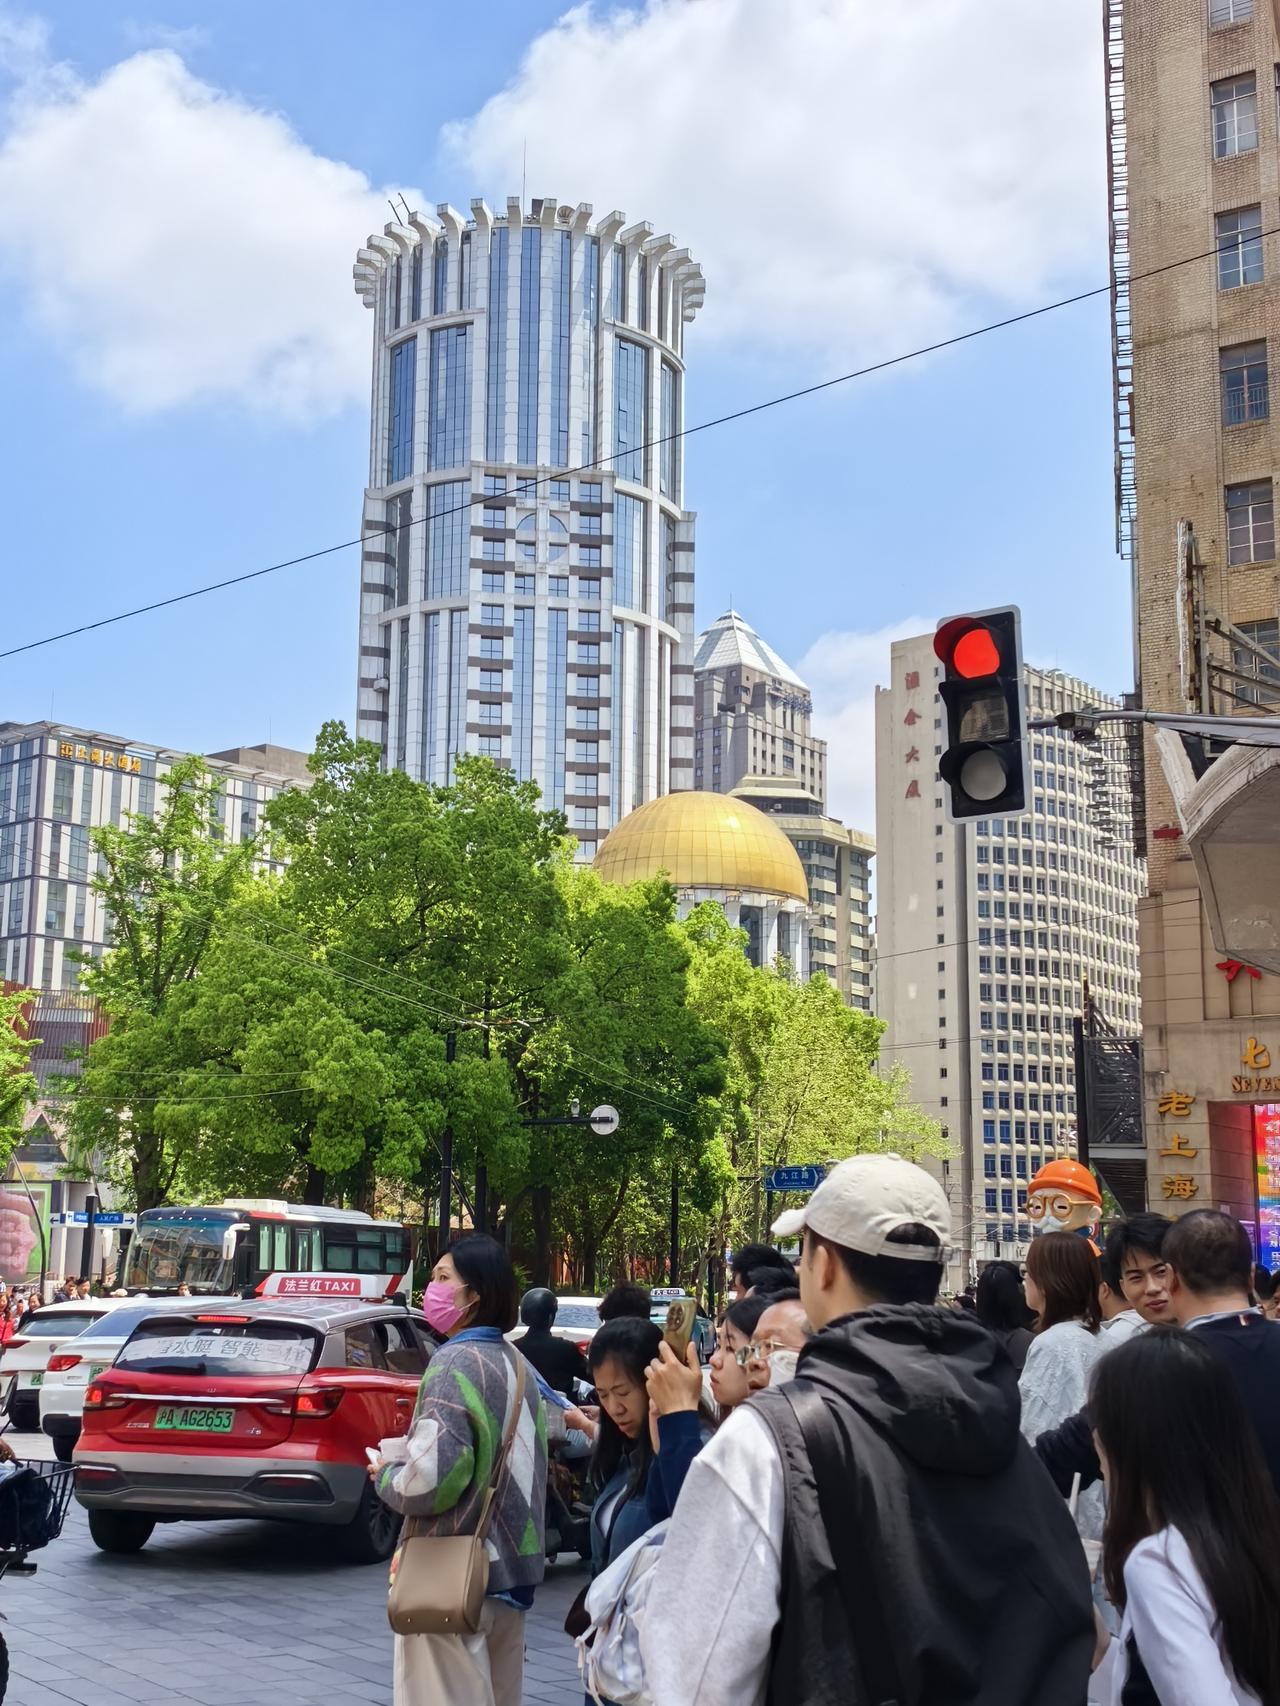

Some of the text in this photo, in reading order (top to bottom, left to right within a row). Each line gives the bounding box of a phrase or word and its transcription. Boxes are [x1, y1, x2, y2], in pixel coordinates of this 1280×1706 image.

[284, 1279, 355, 1292] 法兰红 TAXI
